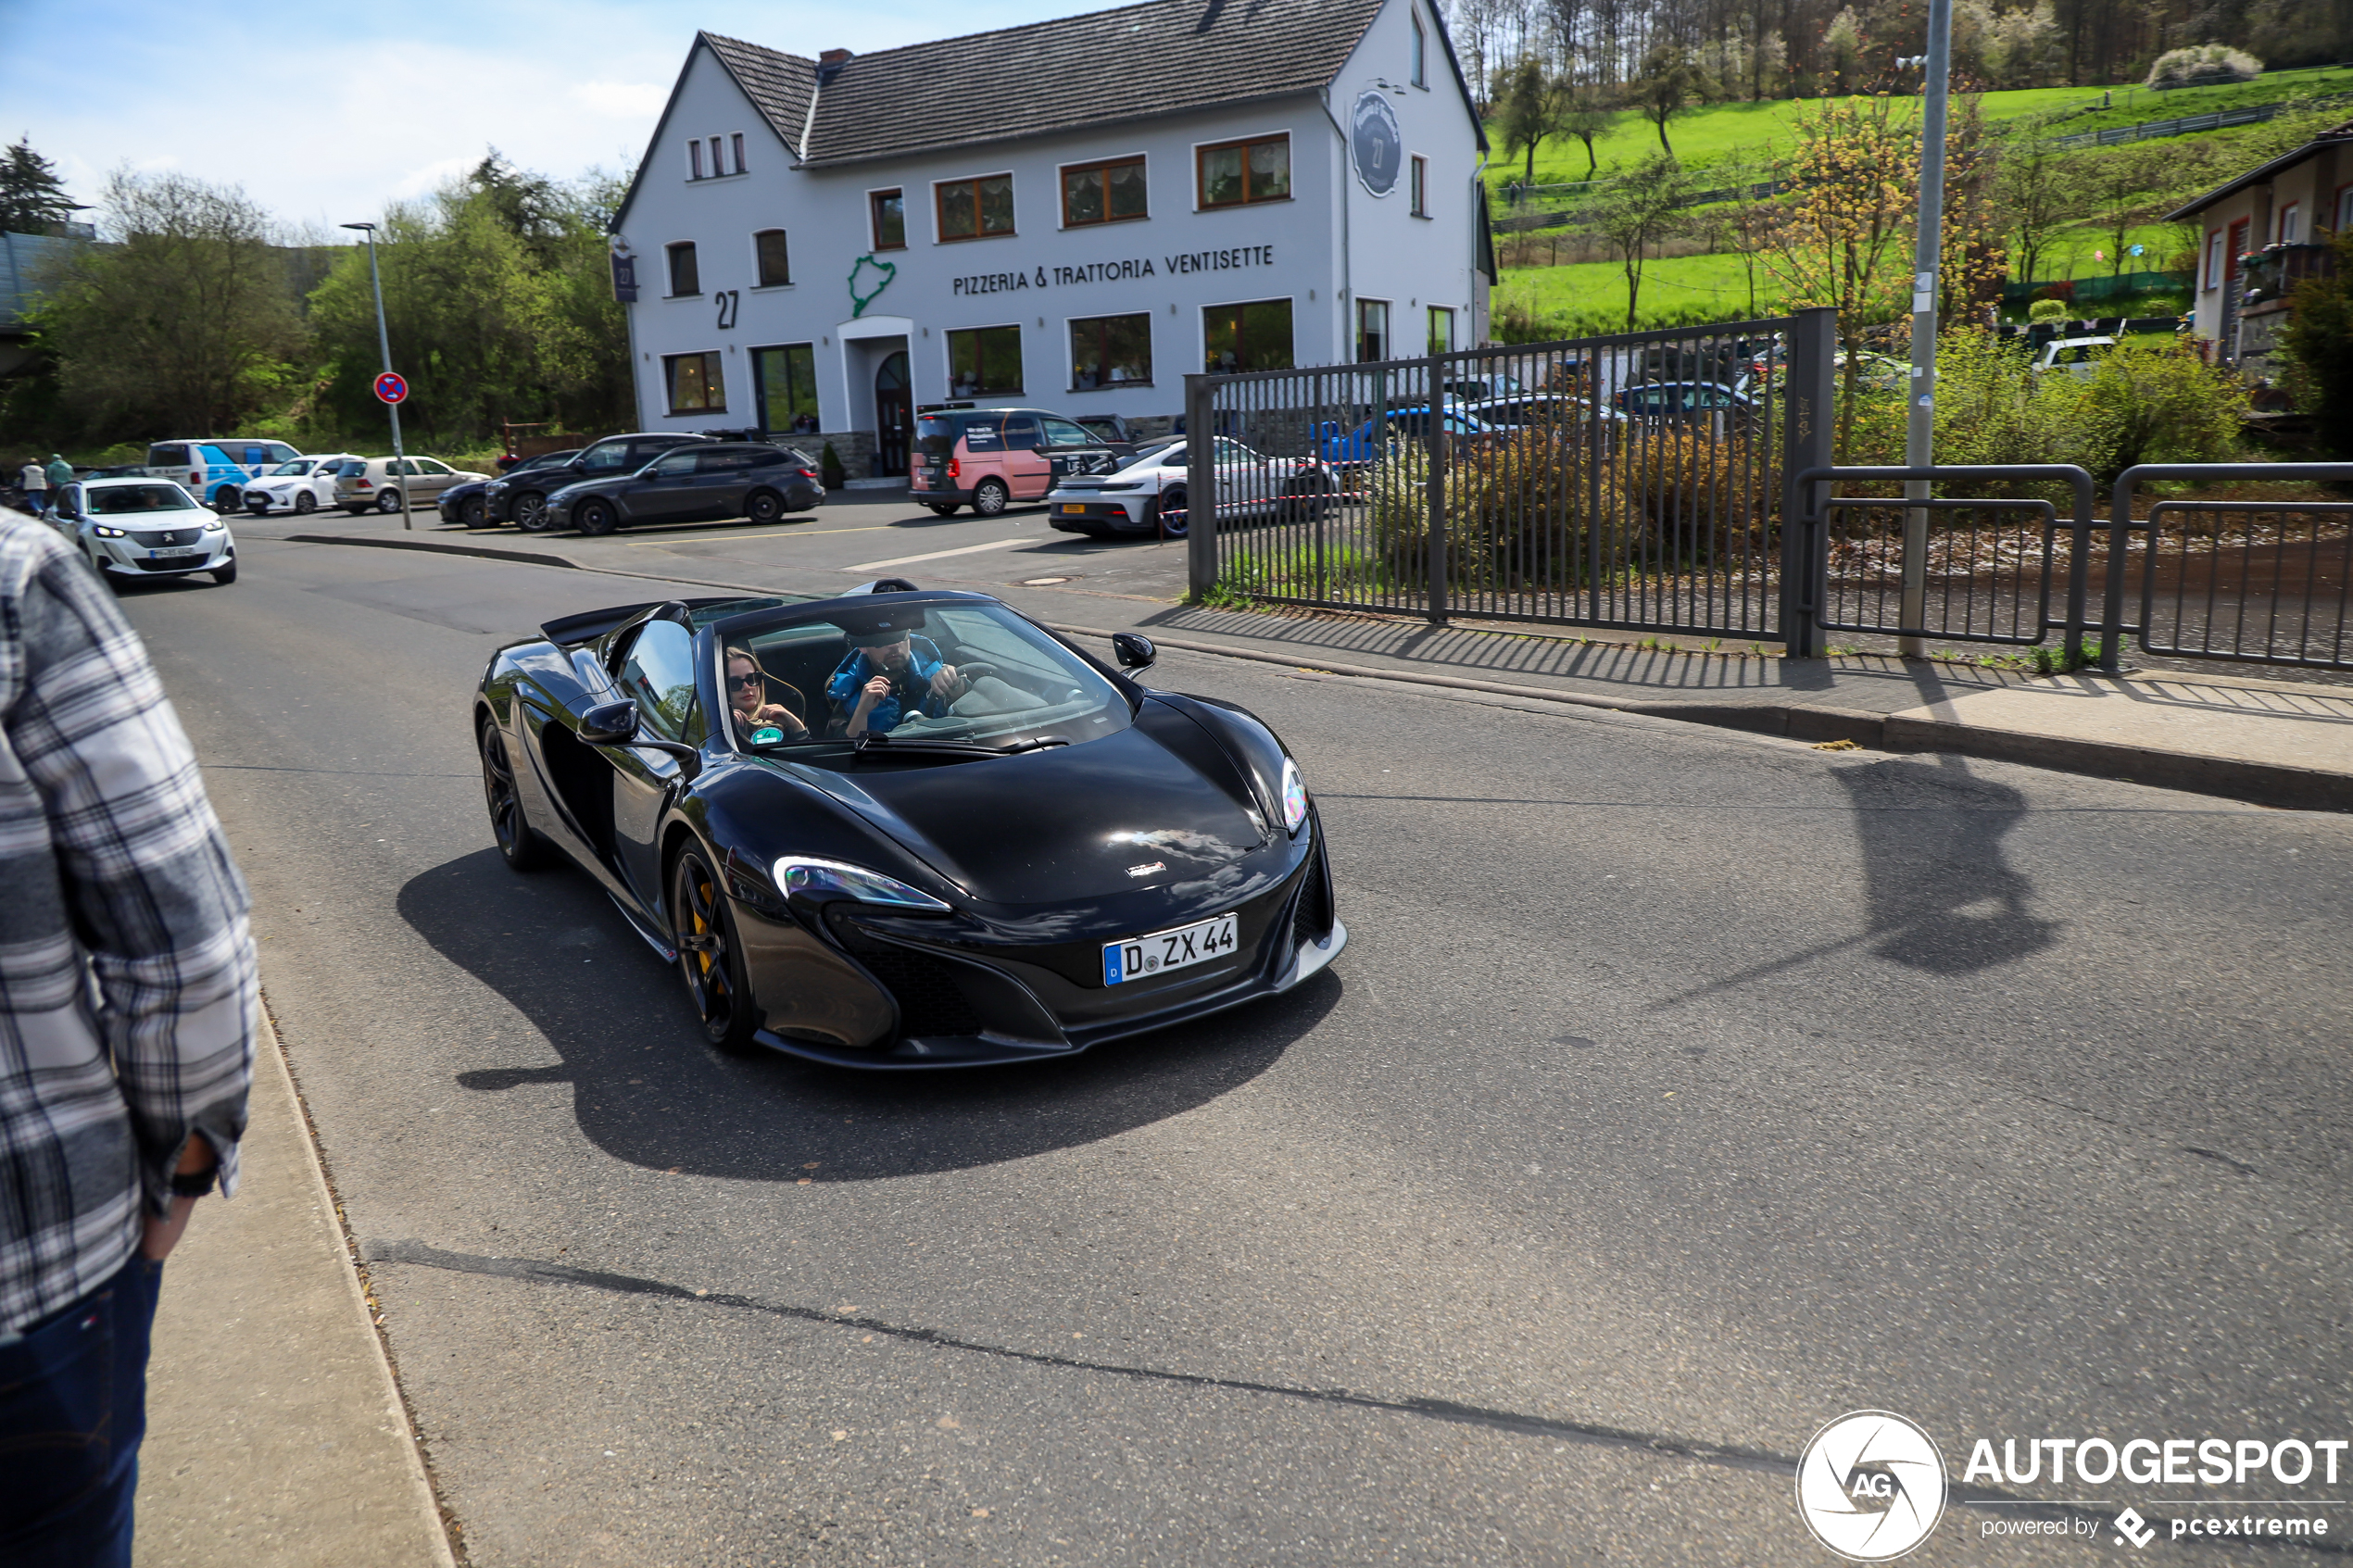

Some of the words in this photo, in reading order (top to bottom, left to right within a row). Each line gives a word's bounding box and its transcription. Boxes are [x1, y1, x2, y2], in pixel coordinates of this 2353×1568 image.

[953, 272, 1028, 295] PIZZERIA
[1035, 266, 1047, 287] &
[1053, 259, 1155, 285] TRATTORIA
[1165, 245, 1273, 274] VENTISETTE
[715, 290, 739, 330] 27
[1126, 946, 1142, 975] D
[1163, 931, 1196, 966] ZX
[1203, 922, 1232, 953] 44
